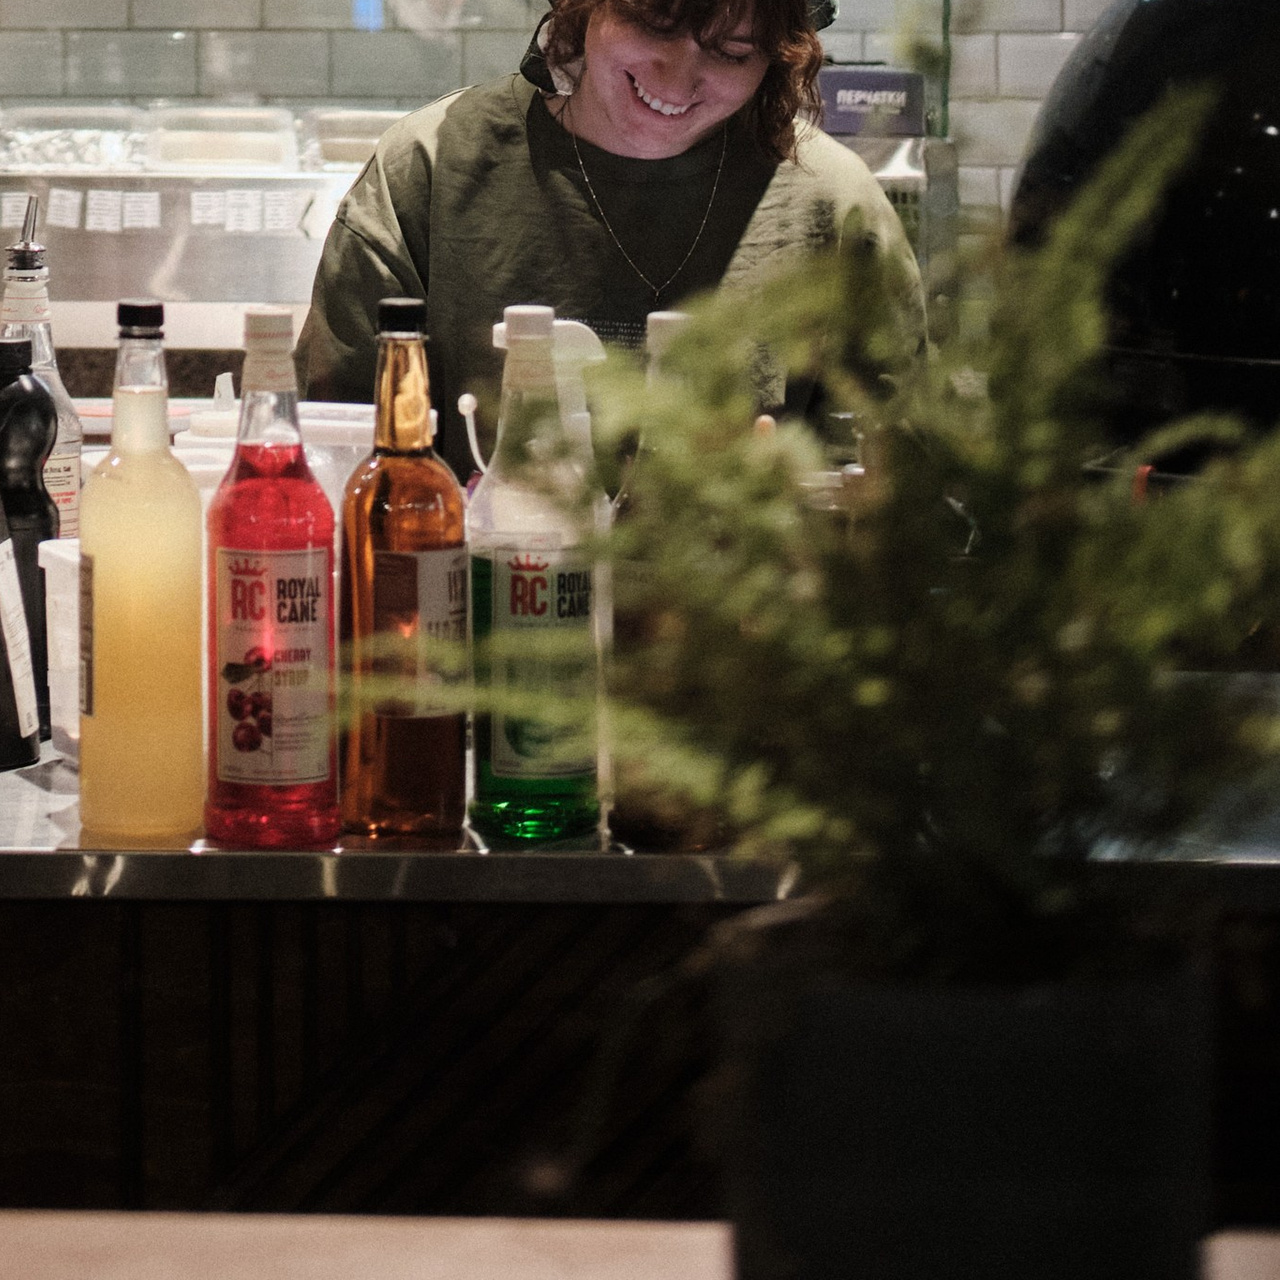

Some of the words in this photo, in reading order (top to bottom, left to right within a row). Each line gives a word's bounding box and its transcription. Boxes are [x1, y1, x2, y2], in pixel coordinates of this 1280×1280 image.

[231, 578, 266, 621] RC
[276, 576, 321, 600] ROYAL
[510, 574, 548, 617] RC
[276, 599, 318, 623] CANE
[274, 648, 311, 663] CHERRY
